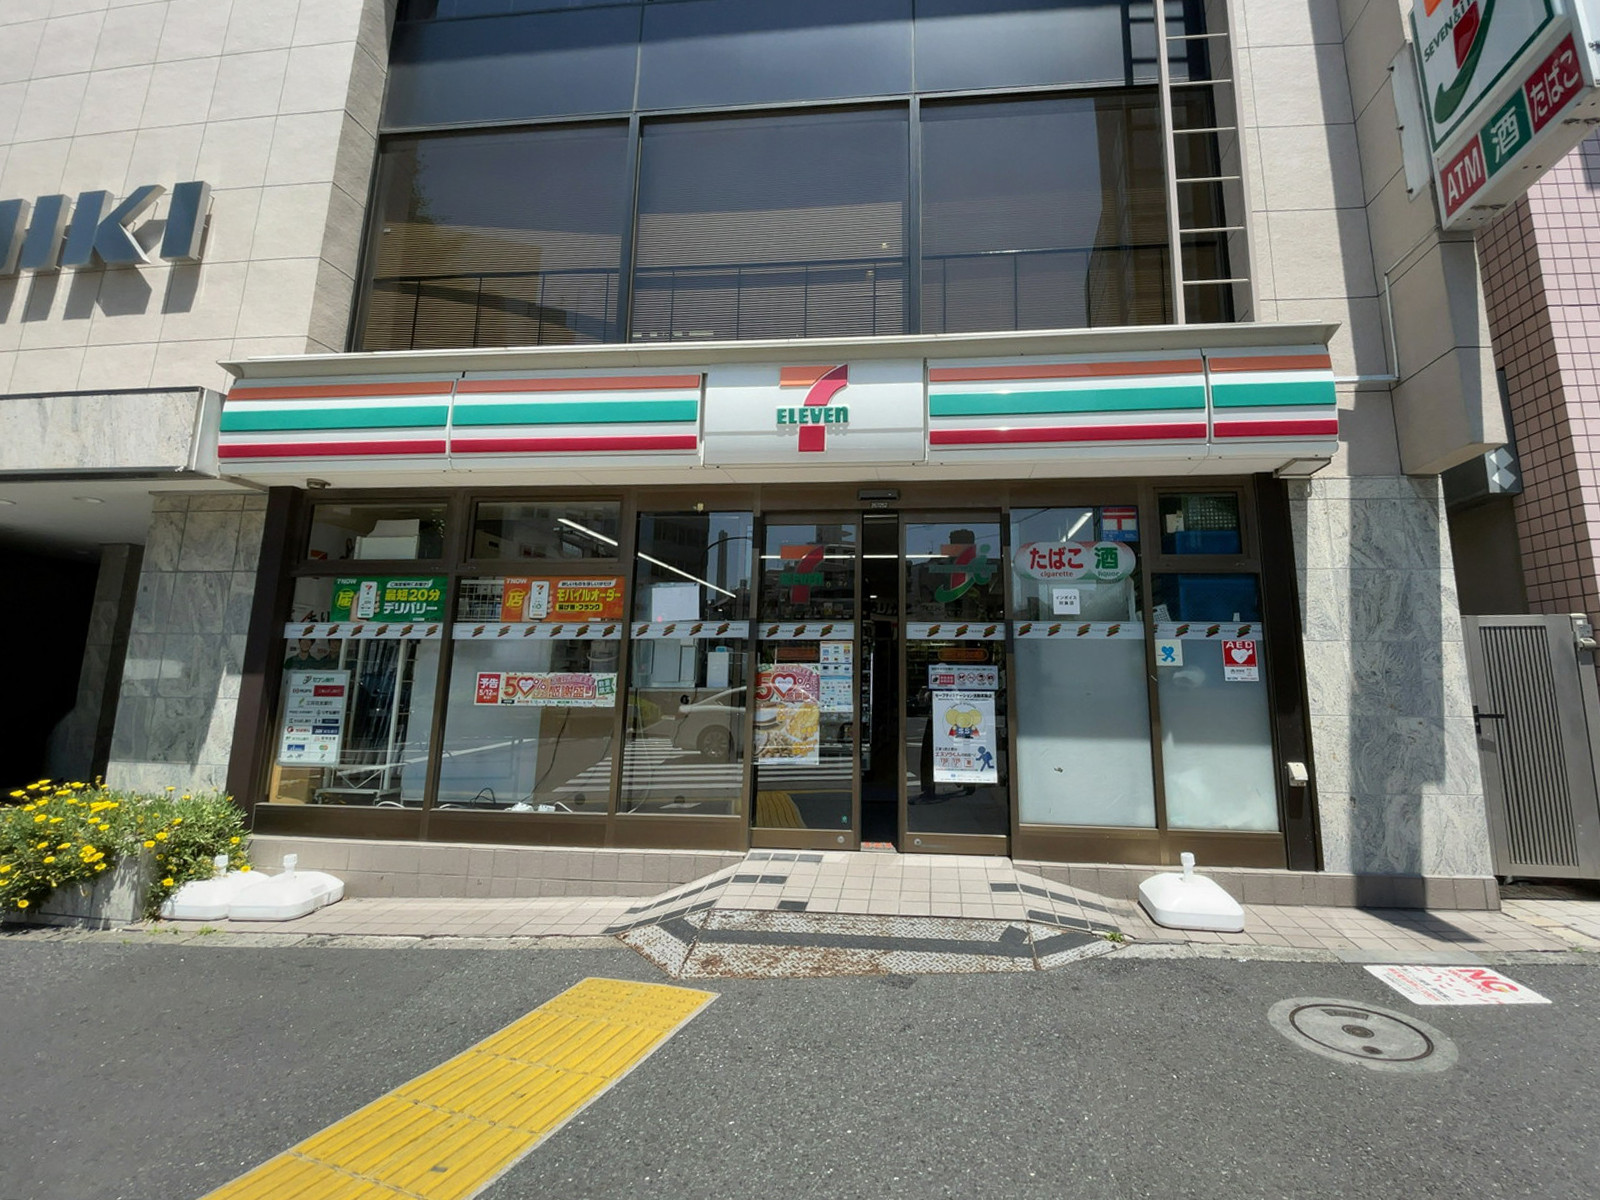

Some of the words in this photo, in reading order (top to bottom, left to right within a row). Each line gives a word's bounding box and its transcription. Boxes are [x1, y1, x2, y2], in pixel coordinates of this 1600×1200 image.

[1446, 146, 1482, 207] ATM
[1490, 106, 1521, 163] 酒
[1529, 48, 1579, 123] たばこ
[1029, 546, 1084, 570] たばこ
[1094, 546, 1119, 570] 酒
[1040, 570, 1074, 578] cigarette
[384, 588, 440, 602] 最短20分
[506, 590, 527, 608] 店
[557, 588, 621, 602] モバイルオーダー
[383, 602, 438, 614] デリバリー
[1226, 641, 1253, 649] AED
[480, 678, 498, 689] 予告
